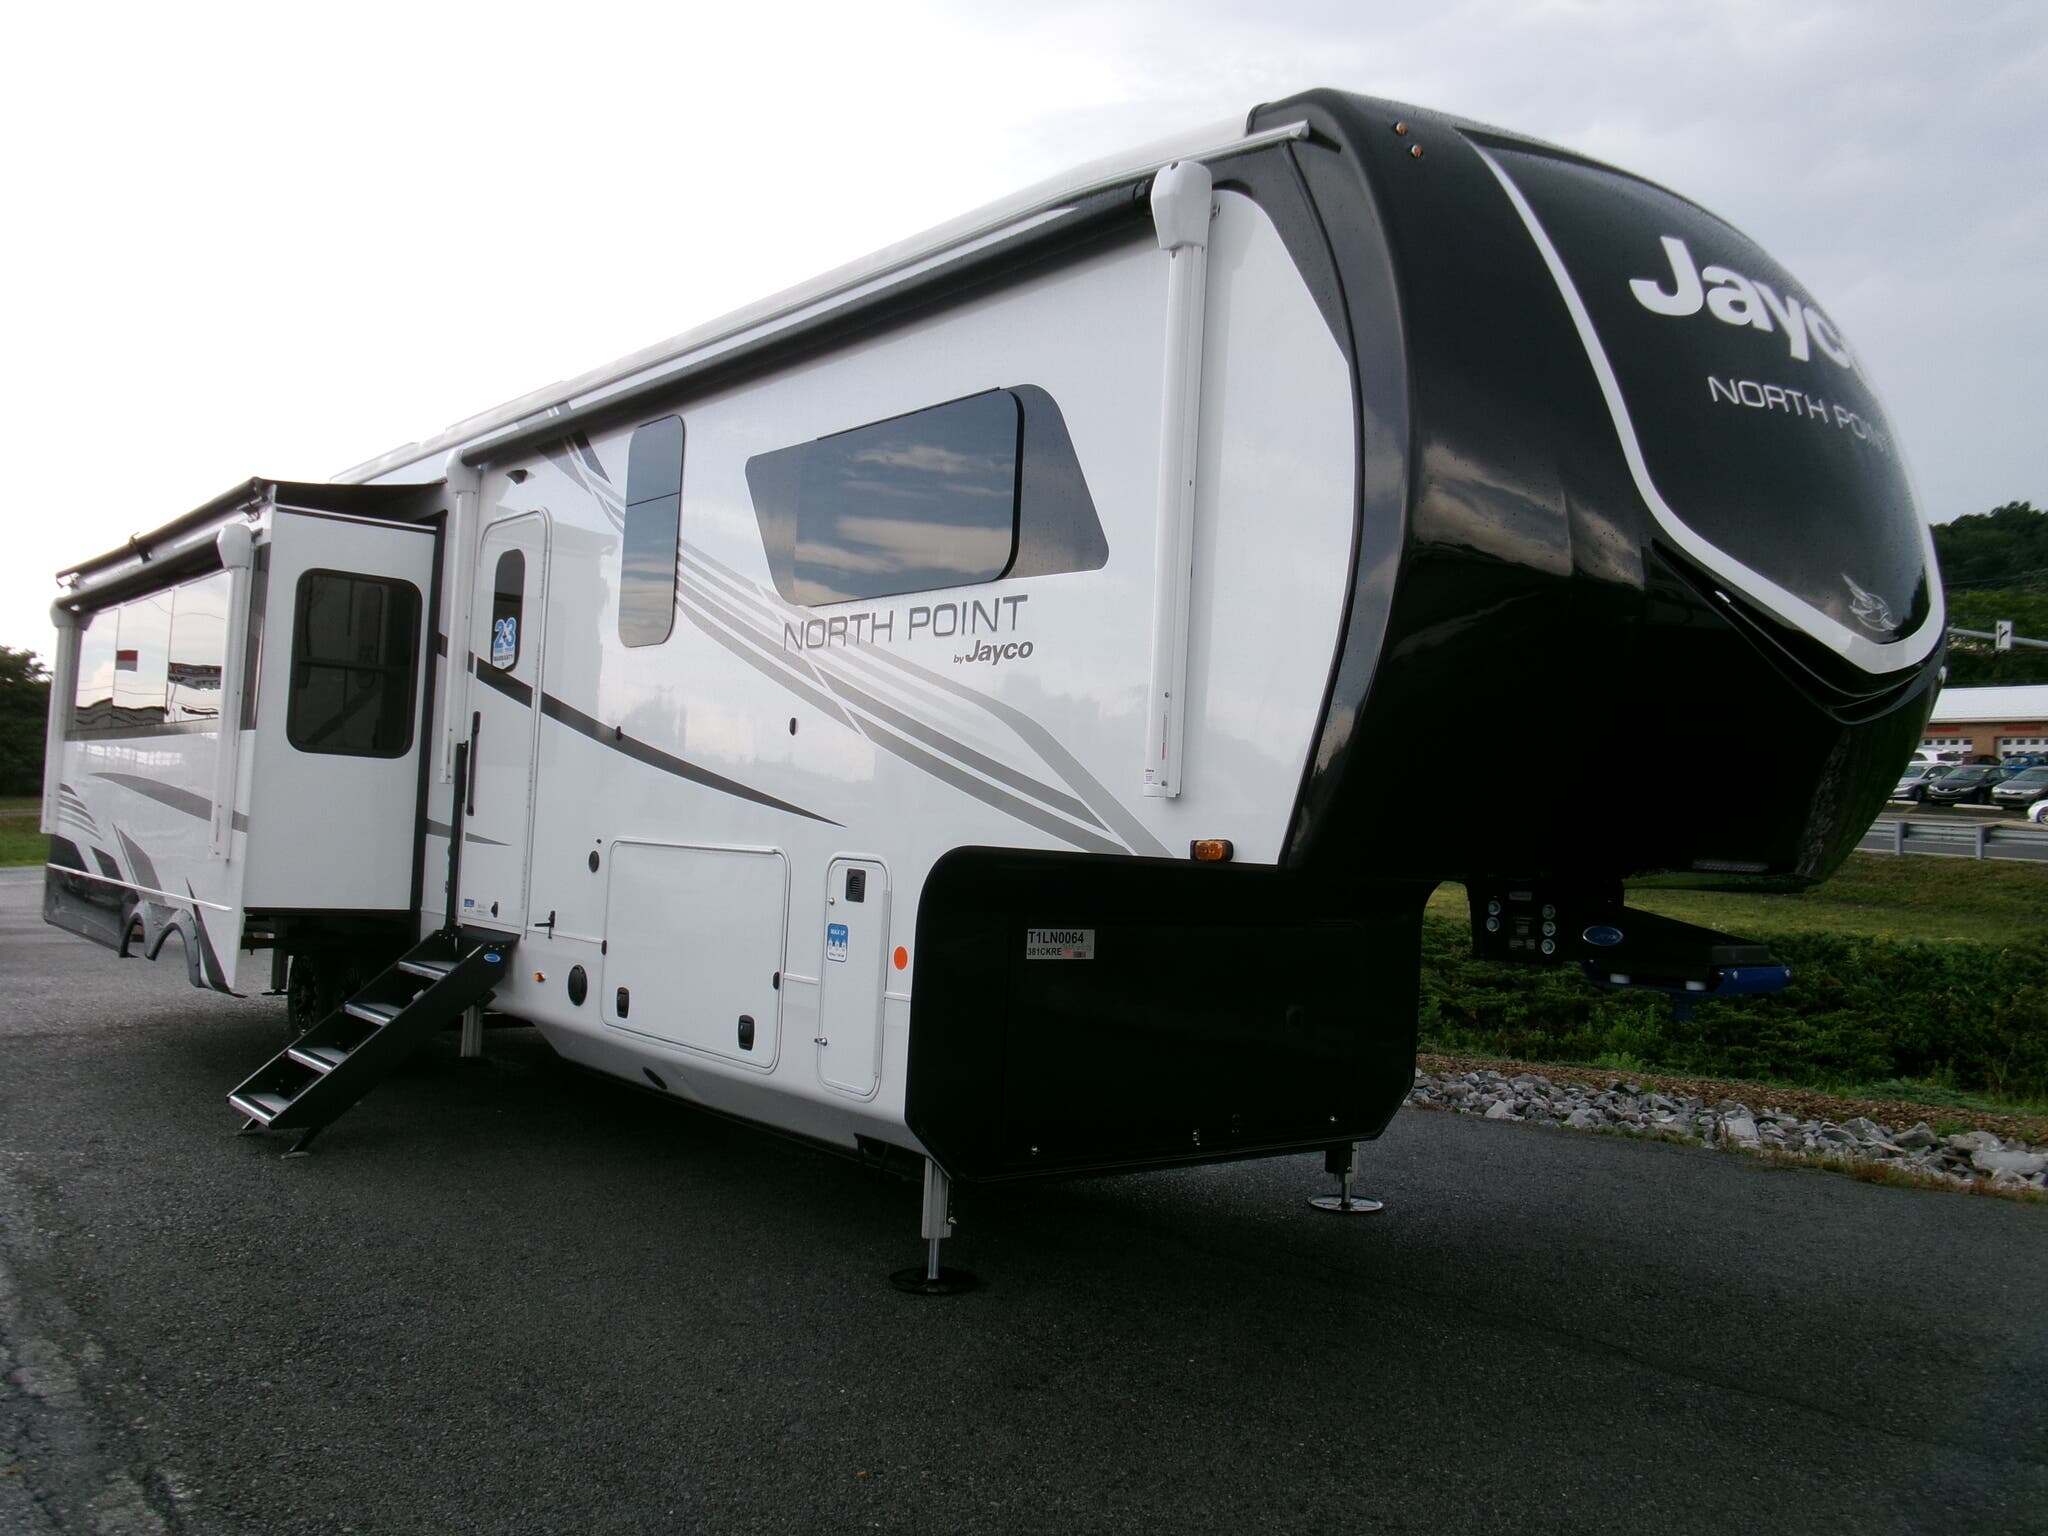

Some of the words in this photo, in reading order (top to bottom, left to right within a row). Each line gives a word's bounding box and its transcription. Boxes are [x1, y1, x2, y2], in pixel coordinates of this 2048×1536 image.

[1628, 235, 1856, 369] Jayc
[1706, 375, 1830, 425] NORTH
[784, 610, 894, 651] NORTH
[908, 594, 1028, 640] POINT
[953, 653, 964, 665] by
[965, 640, 1034, 665] Jayco
[1028, 931, 1084, 944] T1LN0064
